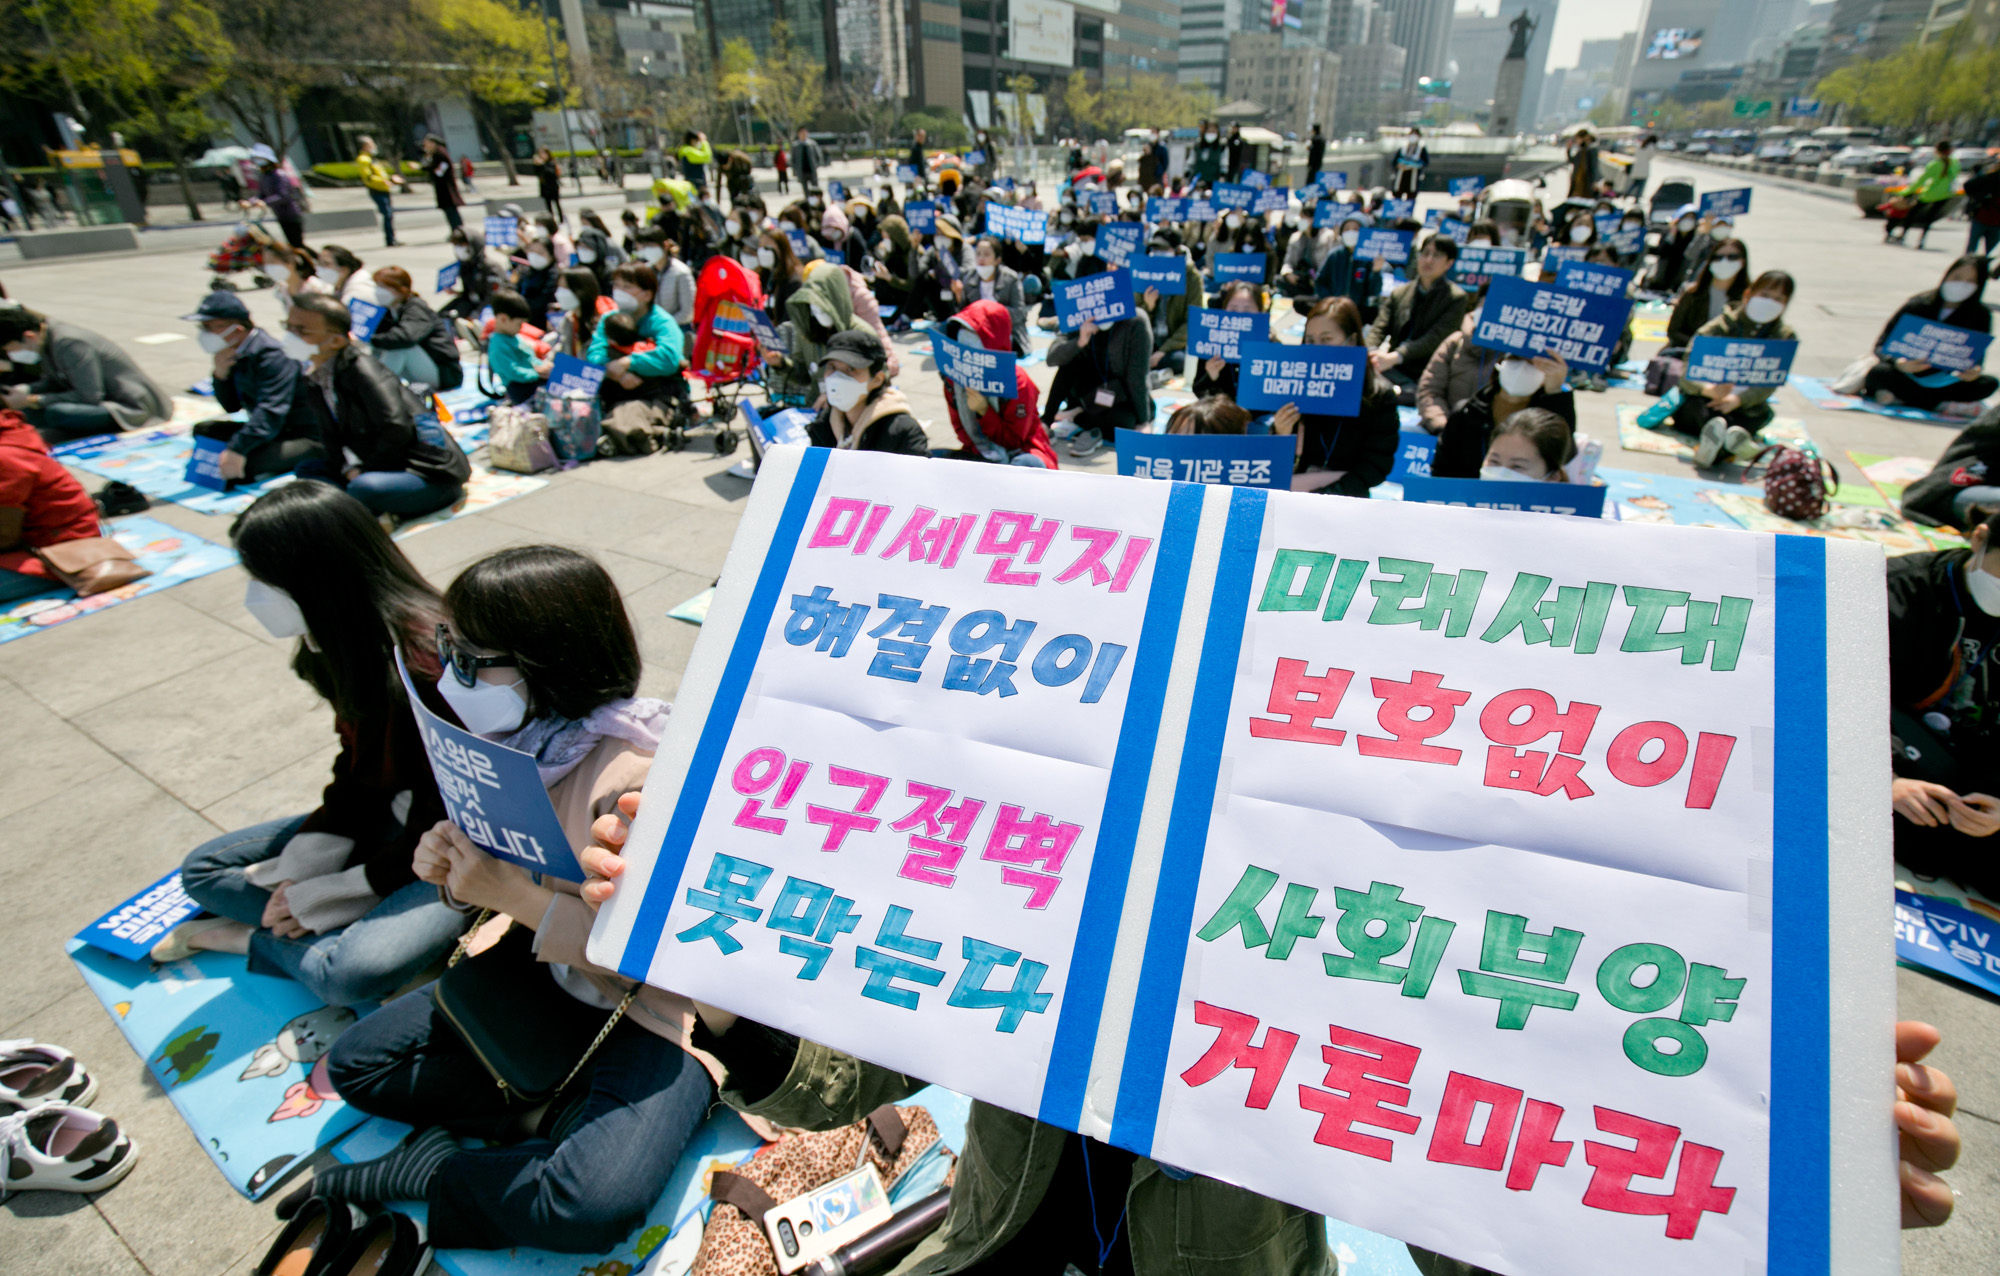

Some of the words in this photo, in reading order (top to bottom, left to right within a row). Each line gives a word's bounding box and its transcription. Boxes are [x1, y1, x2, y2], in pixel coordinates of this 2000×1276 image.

[1065, 283, 1084, 299] 저의
[1085, 276, 1115, 294] 소원은
[1076, 293, 1106, 311] 마음껏
[1095, 302, 1125, 321] 입니다
[1531, 289, 1587, 318] 중국발
[1201, 313, 1218, 329] 저의
[1220, 316, 1253, 331] 소원은
[1209, 329, 1240, 344] 마음껏
[1478, 321, 1528, 349] 대책을
[1499, 304, 1568, 336] 발암먼지
[1567, 321, 1604, 344] 해결
[941, 339, 960, 359] 저의
[962, 350, 997, 369] 소원은
[953, 358, 984, 379] 마음껏
[1251, 359, 1277, 377] 공기
[1310, 362, 1353, 381] 나라엔
[968, 378, 1005, 394] 입니다
[1263, 378, 1304, 396] 미래가
[1307, 380, 1336, 397] 없다
[1134, 455, 1174, 480] 교육
[1179, 459, 1224, 483] 기관
[1228, 460, 1271, 484] 공조
[1406, 460, 1432, 478] 시스
[806, 495, 1153, 593] 미세먼지
[1257, 547, 1754, 672] 미래세대
[783, 585, 1128, 704] 해결없이
[1249, 656, 1737, 810] 보호없이
[430, 727, 501, 789] 소원은
[434, 762, 486, 816] 음껏
[460, 810, 547, 865] 입니다
[731, 746, 1082, 911] 인구절벽
[675, 852, 1054, 1034] 못막는다
[1894, 919, 1940, 952] 기
[1196, 864, 1748, 1077] 사회부양
[1180, 999, 1738, 1241] 거론마라
